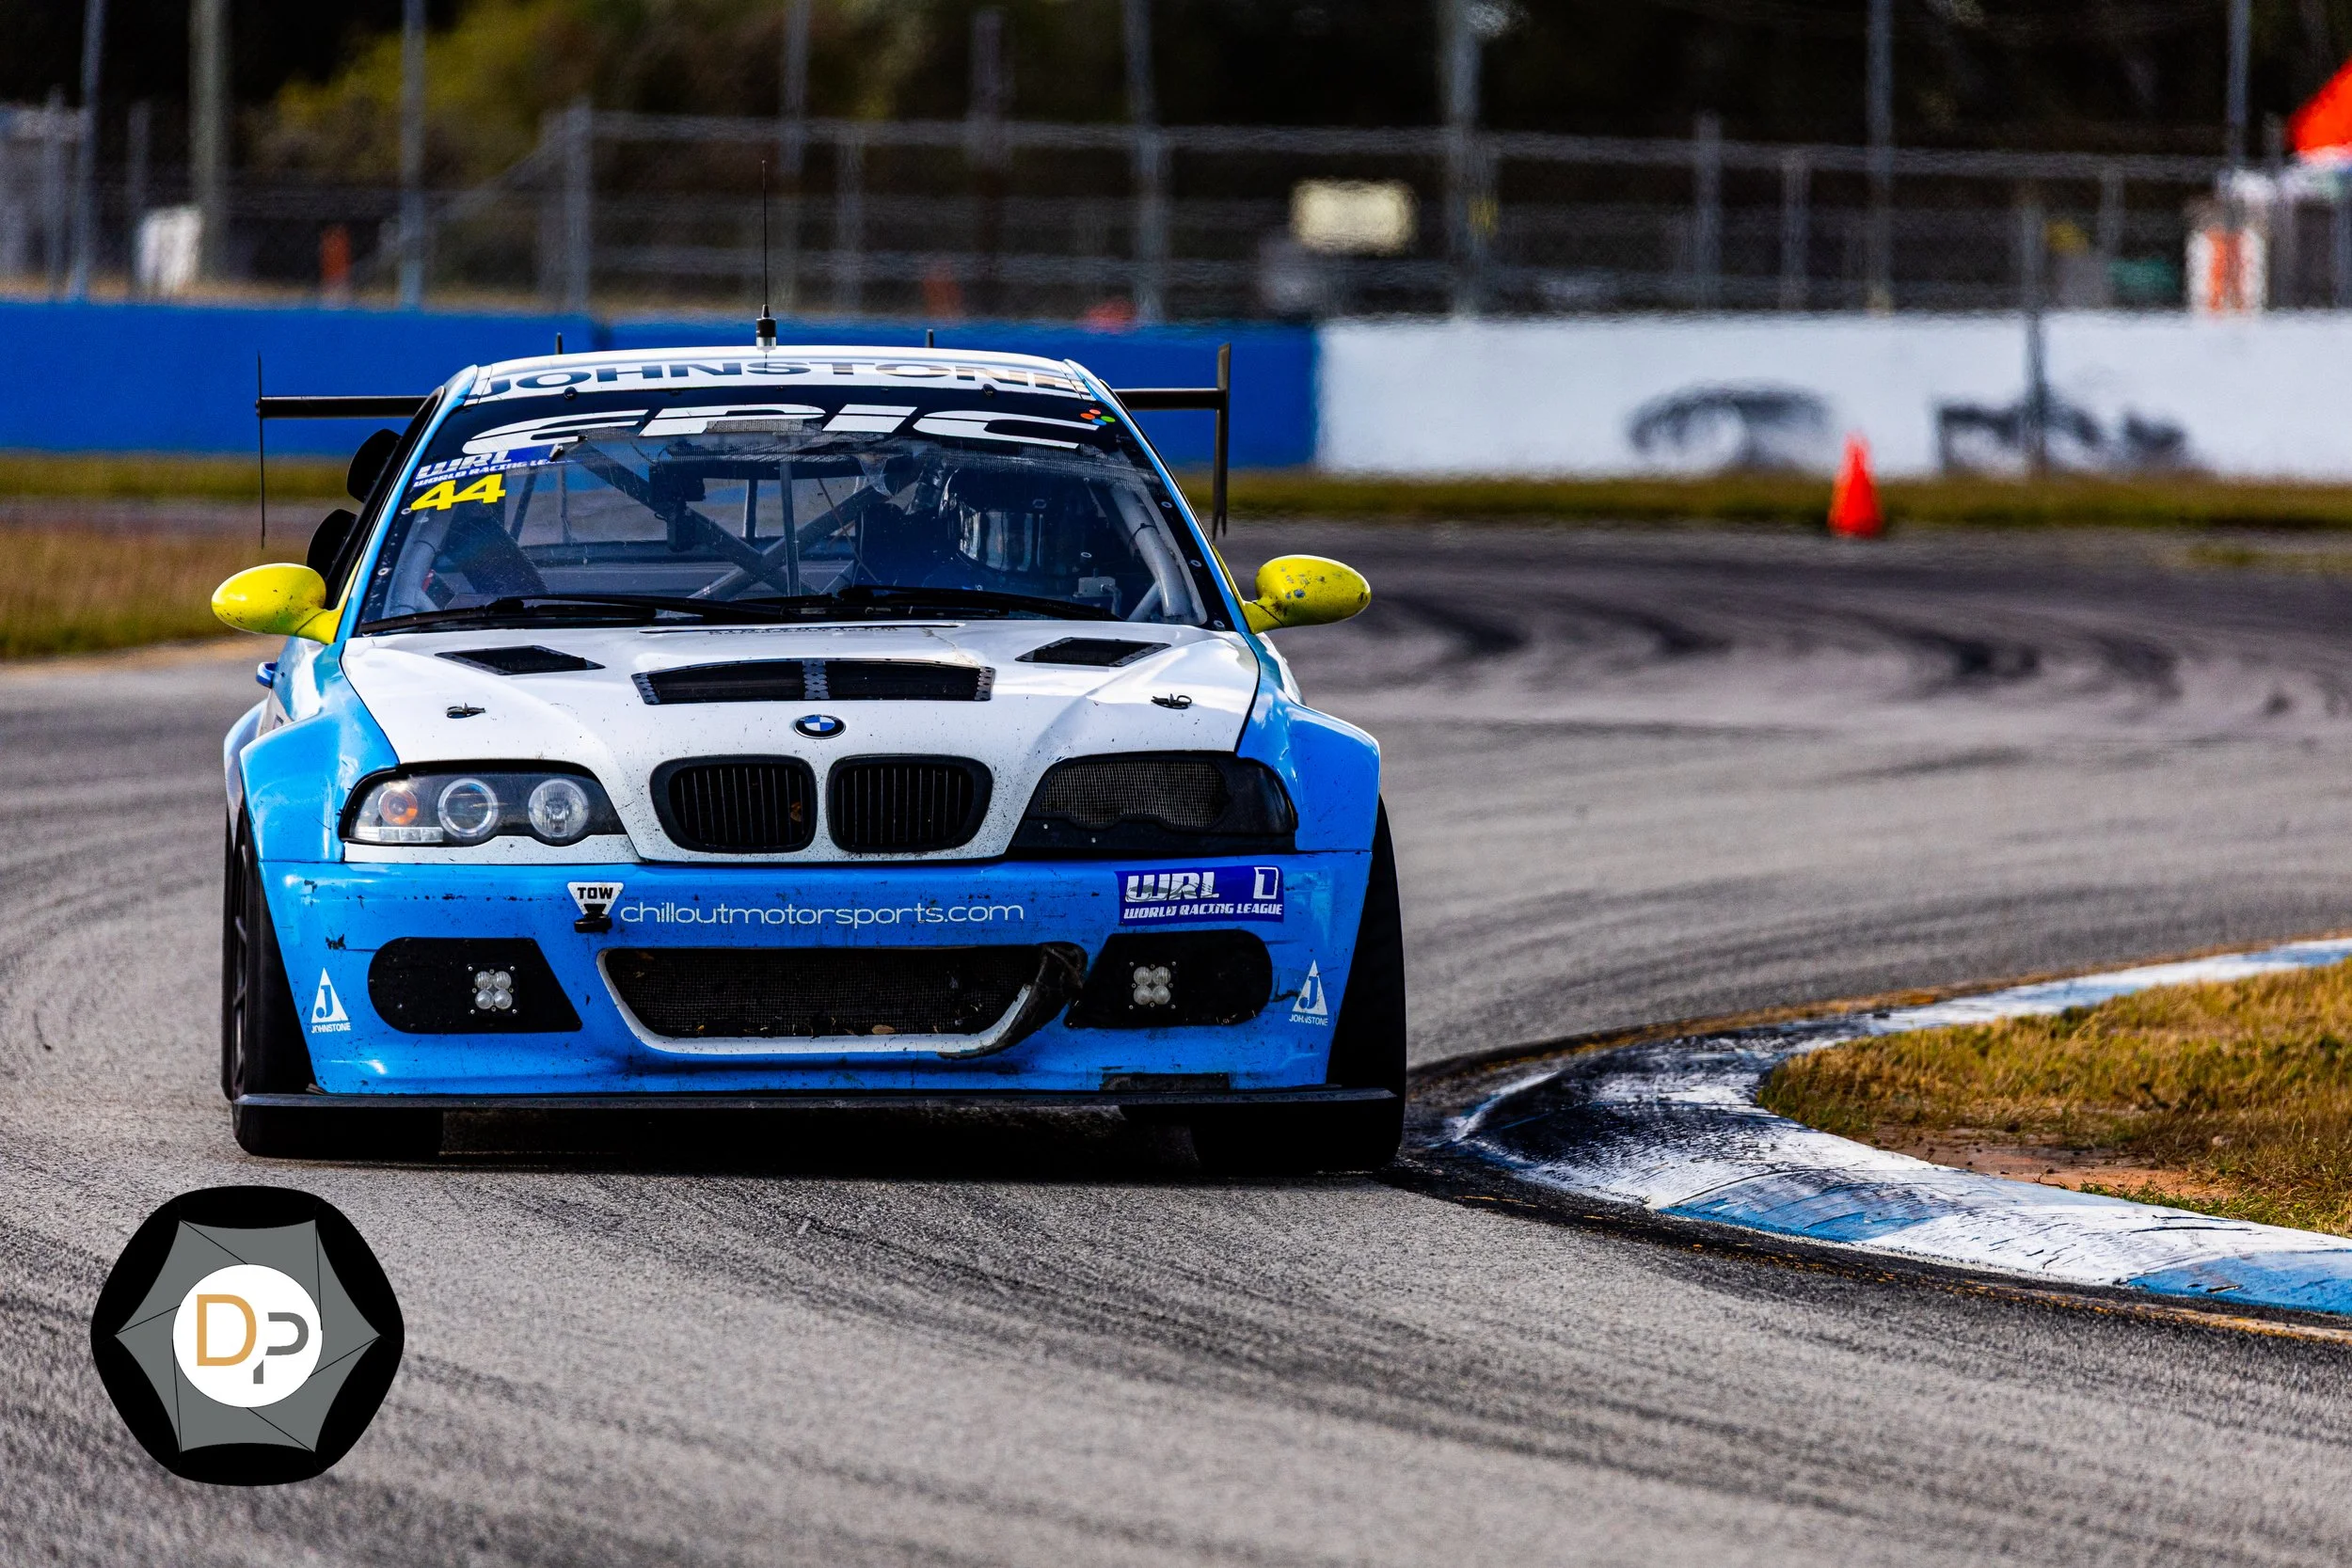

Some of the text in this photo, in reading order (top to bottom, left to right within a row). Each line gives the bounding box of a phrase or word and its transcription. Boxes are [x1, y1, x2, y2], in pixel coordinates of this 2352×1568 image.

[467, 360, 1091, 397] JOHNSTONE
[413, 471, 467, 487] WORLD
[469, 462, 528, 476] RACING
[415, 450, 512, 480] WRL
[410, 473, 505, 511] 44
[577, 887, 613, 899] TOW
[1124, 871, 1219, 903] WRL
[620, 901, 1025, 929] chilloutmotorsports.com
[1123, 903, 1283, 919] WORLD RACING LEAGUE
[311, 1022, 351, 1033] JOHNSTONE
[1289, 1014, 1328, 1026] JOHNSTONE
